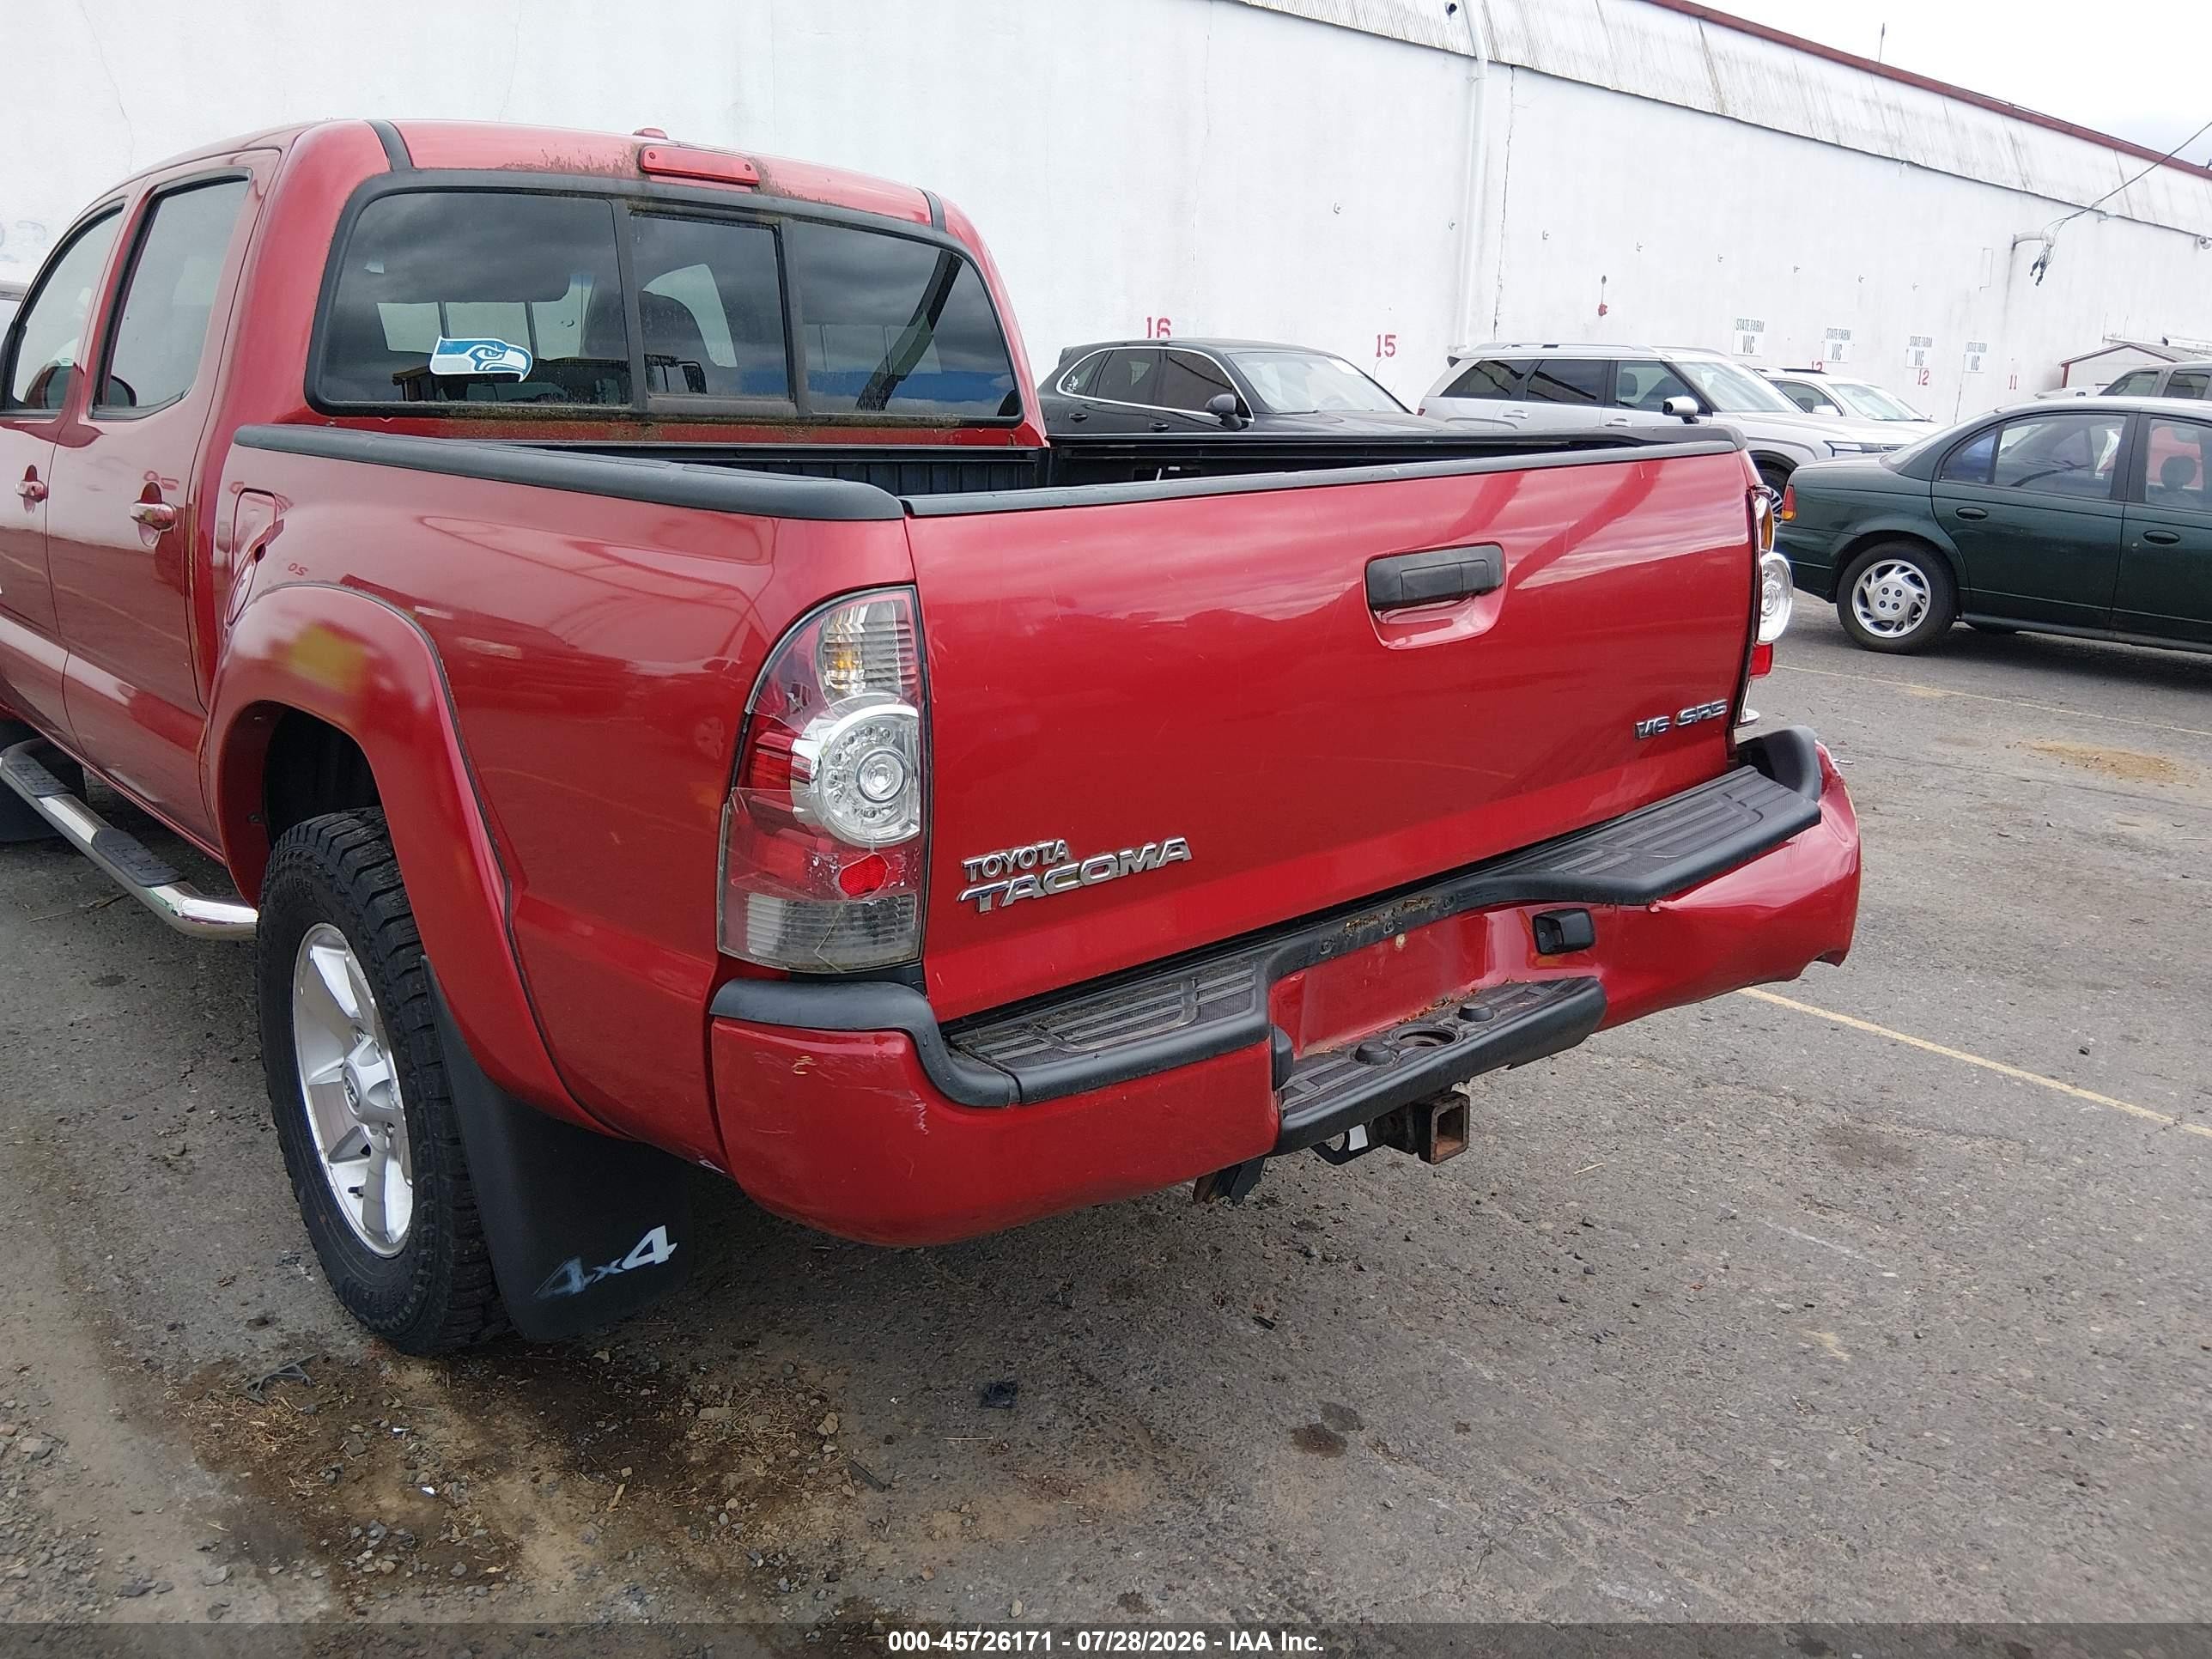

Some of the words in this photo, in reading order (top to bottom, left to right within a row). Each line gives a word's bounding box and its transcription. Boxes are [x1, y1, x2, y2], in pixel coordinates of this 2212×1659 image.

[1146, 316, 1171, 339] 16
[1735, 318, 1750, 332] STATE
[1750, 319, 1765, 333] FARM
[1826, 327, 1838, 340] STATE
[1838, 329, 1851, 341] FARM
[1376, 334, 1397, 358] 15
[1742, 335, 1755, 354] VIC
[1832, 343, 1843, 361] VIC
[1914, 349, 1924, 367] VIC
[1971, 356, 1980, 371] VIC
[1917, 368, 1929, 386] 12
[2009, 374, 2018, 390] 11
[1634, 715, 1670, 739] V6
[1674, 698, 1728, 727] SR5
[962, 838, 1072, 883] TOYOTA
[957, 836, 1193, 914] TACOMA
